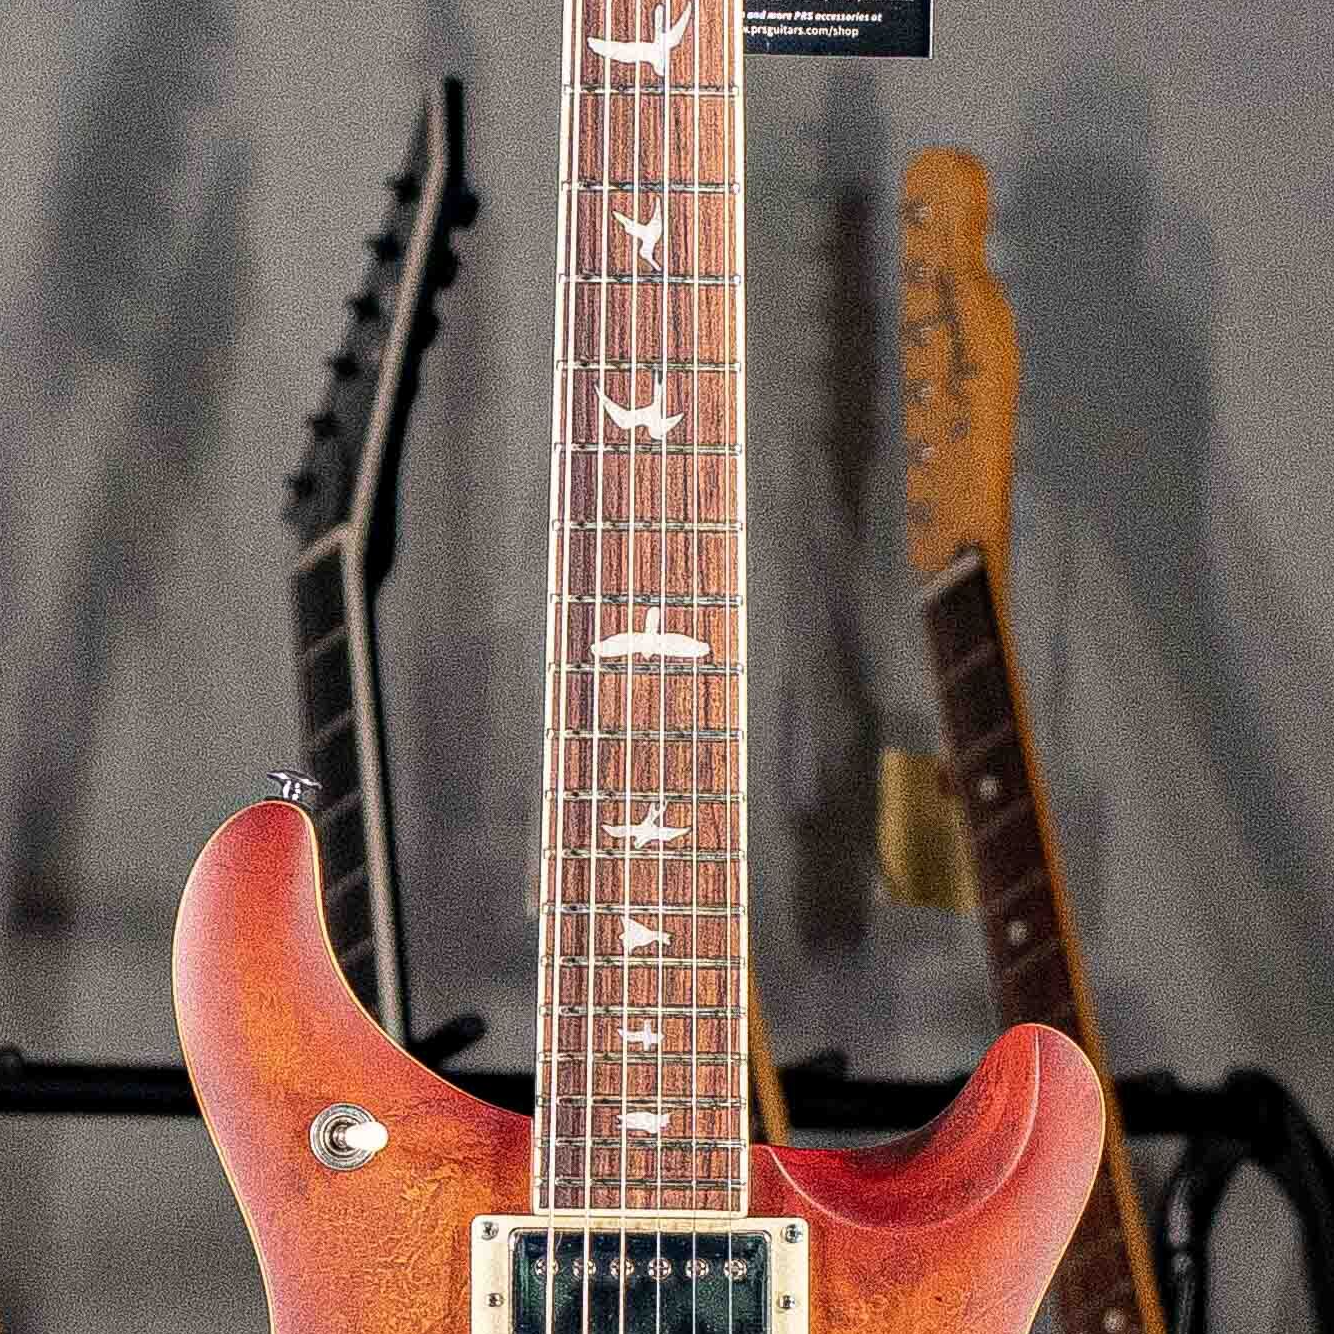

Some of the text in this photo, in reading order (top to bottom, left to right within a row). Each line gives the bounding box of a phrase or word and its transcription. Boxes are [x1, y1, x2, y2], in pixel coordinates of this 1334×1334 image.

[793, 11, 814, 21] PRS
[815, 11, 870, 22] accessories
[871, 13, 882, 22] at
